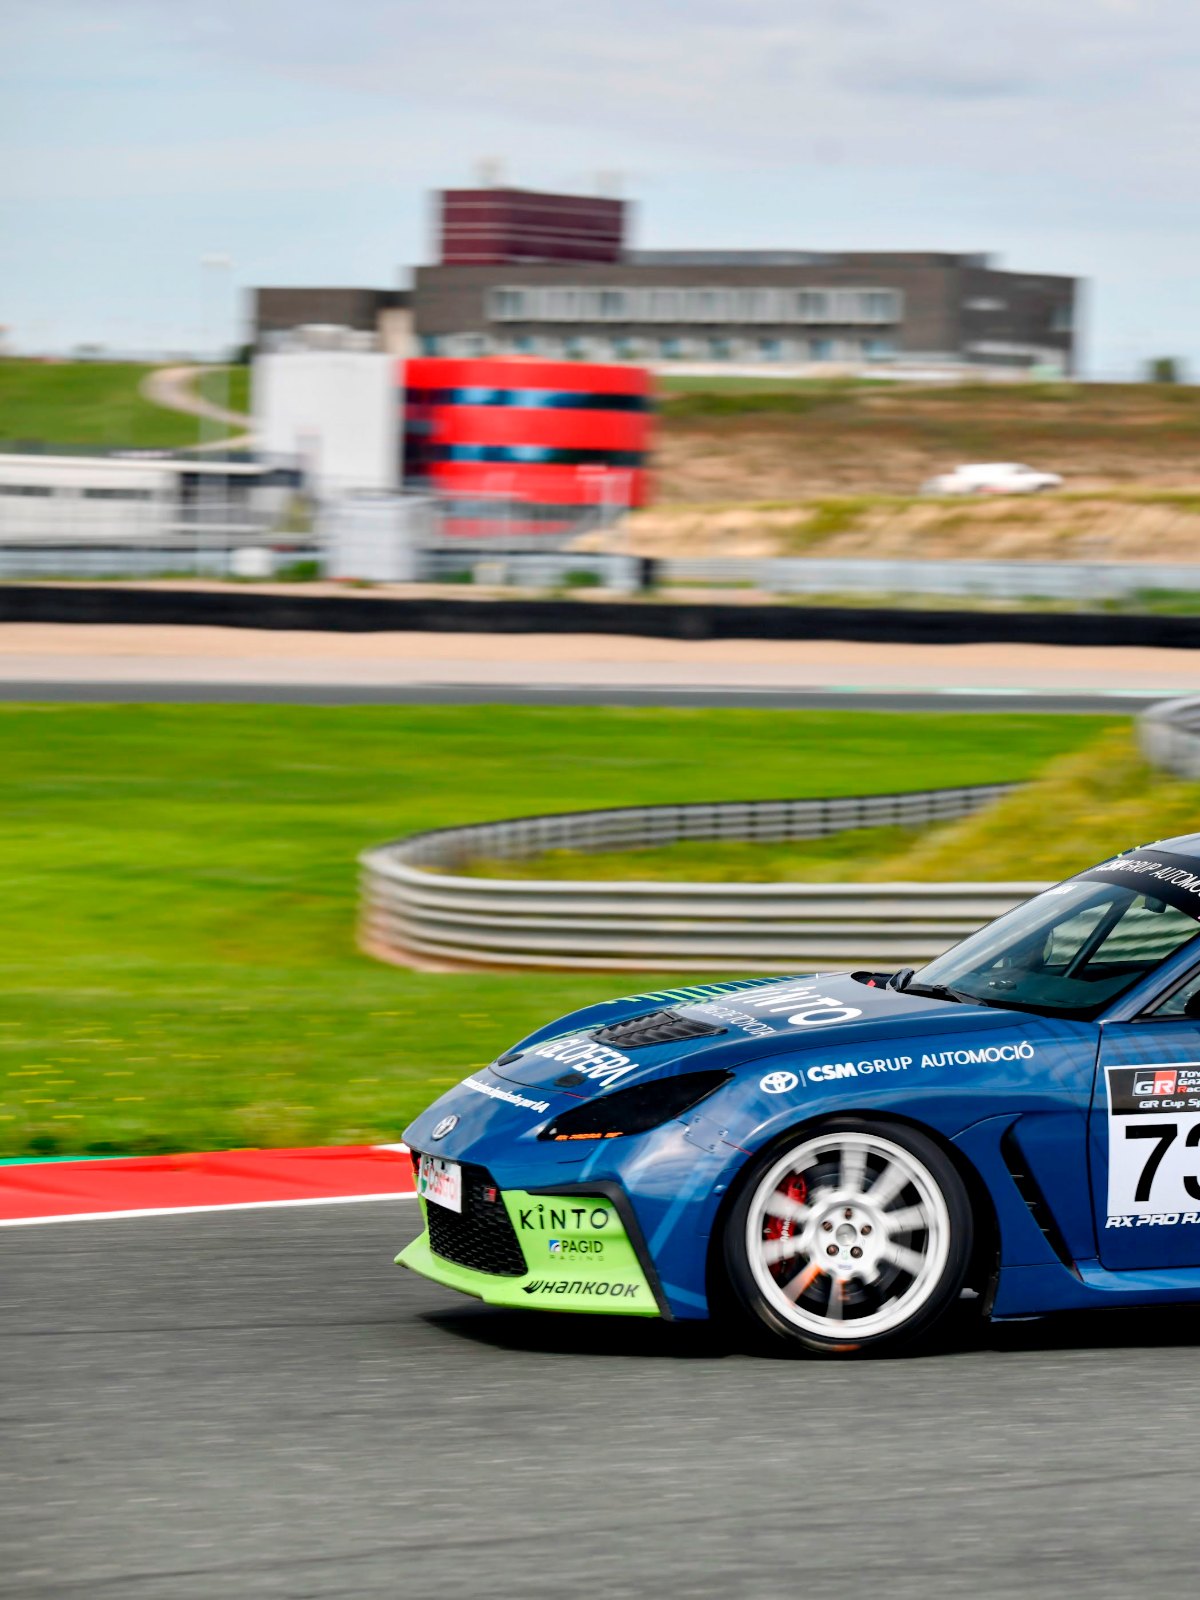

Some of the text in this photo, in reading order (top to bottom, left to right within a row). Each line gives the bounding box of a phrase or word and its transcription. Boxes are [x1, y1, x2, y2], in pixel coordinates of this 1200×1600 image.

[920, 1040, 1035, 1069] AUTOMOCIÓ
[1134, 1080, 1175, 1095] GR
[1139, 1100, 1160, 1109] GR
[1161, 1099, 1186, 1109] Cup
[1105, 1215, 1133, 1228] RX
[1135, 1212, 1181, 1227] PRO
[561, 1240, 603, 1254] PAGID
